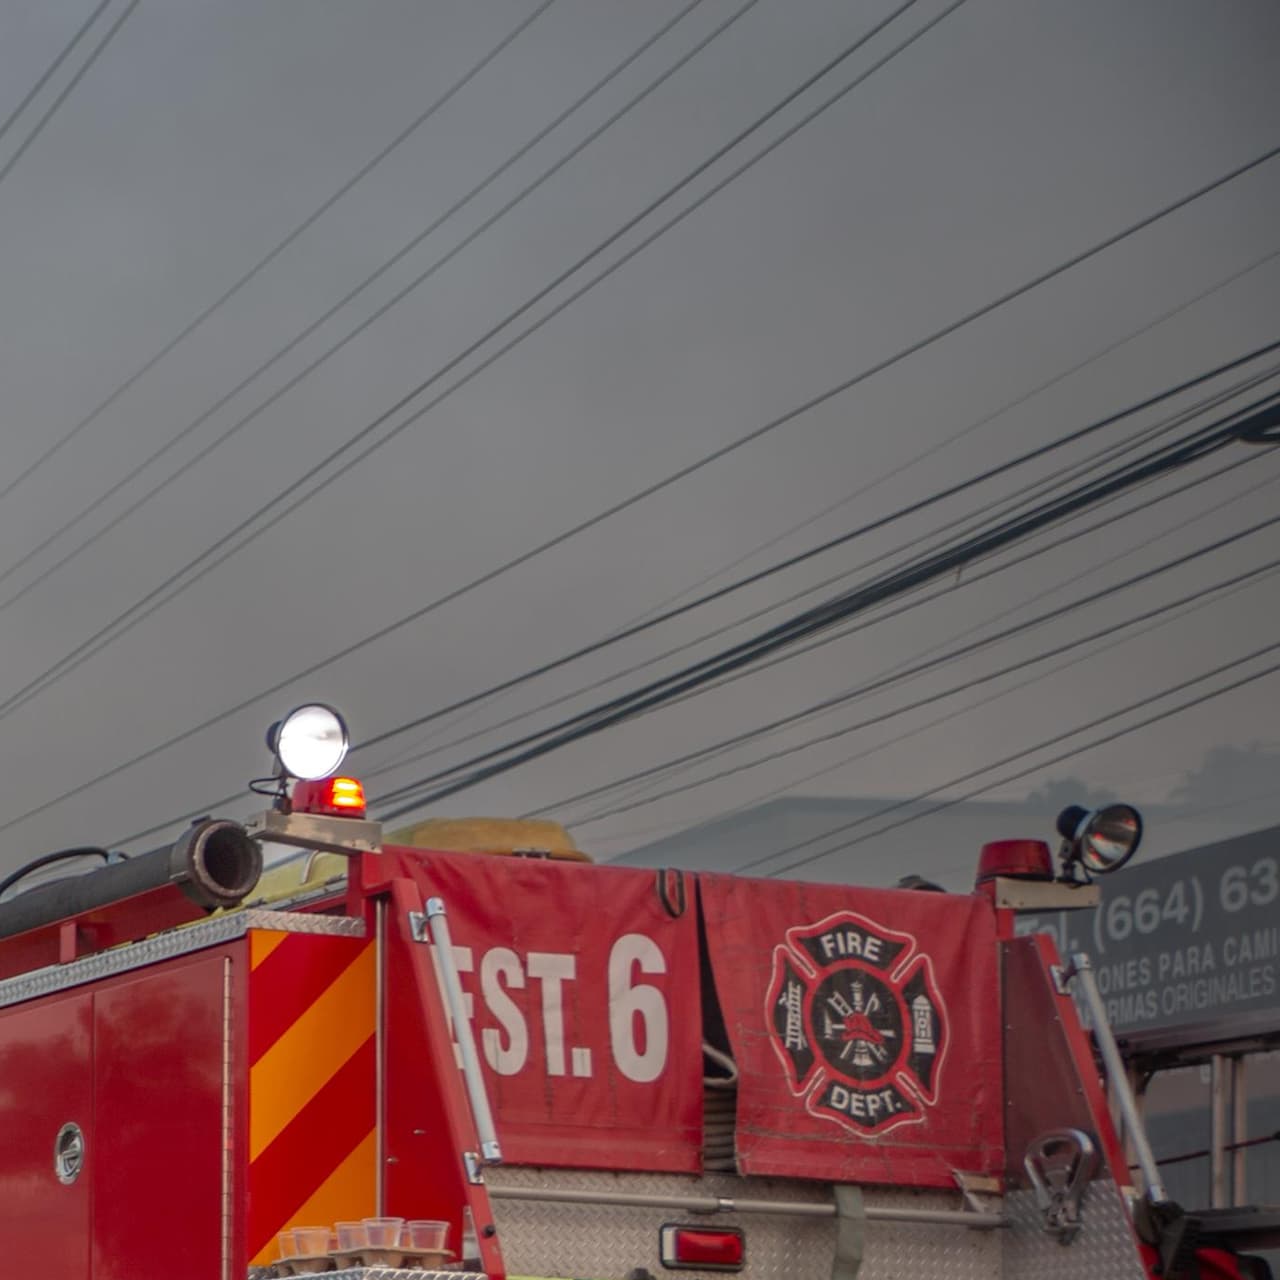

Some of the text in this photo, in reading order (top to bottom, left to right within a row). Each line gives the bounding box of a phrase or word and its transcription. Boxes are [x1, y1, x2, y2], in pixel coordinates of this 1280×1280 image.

[1094, 876, 1204, 954] (664)
[1220, 857, 1279, 913] 63
[820, 931, 883, 962] FIRE
[1096, 955, 1152, 995] ONES
[1159, 941, 1216, 981] PARA
[608, 933, 669, 1083] 6
[1106, 964, 1276, 1026] RMAS ORIGINALES
[830, 1085, 903, 1118] DEPT.
